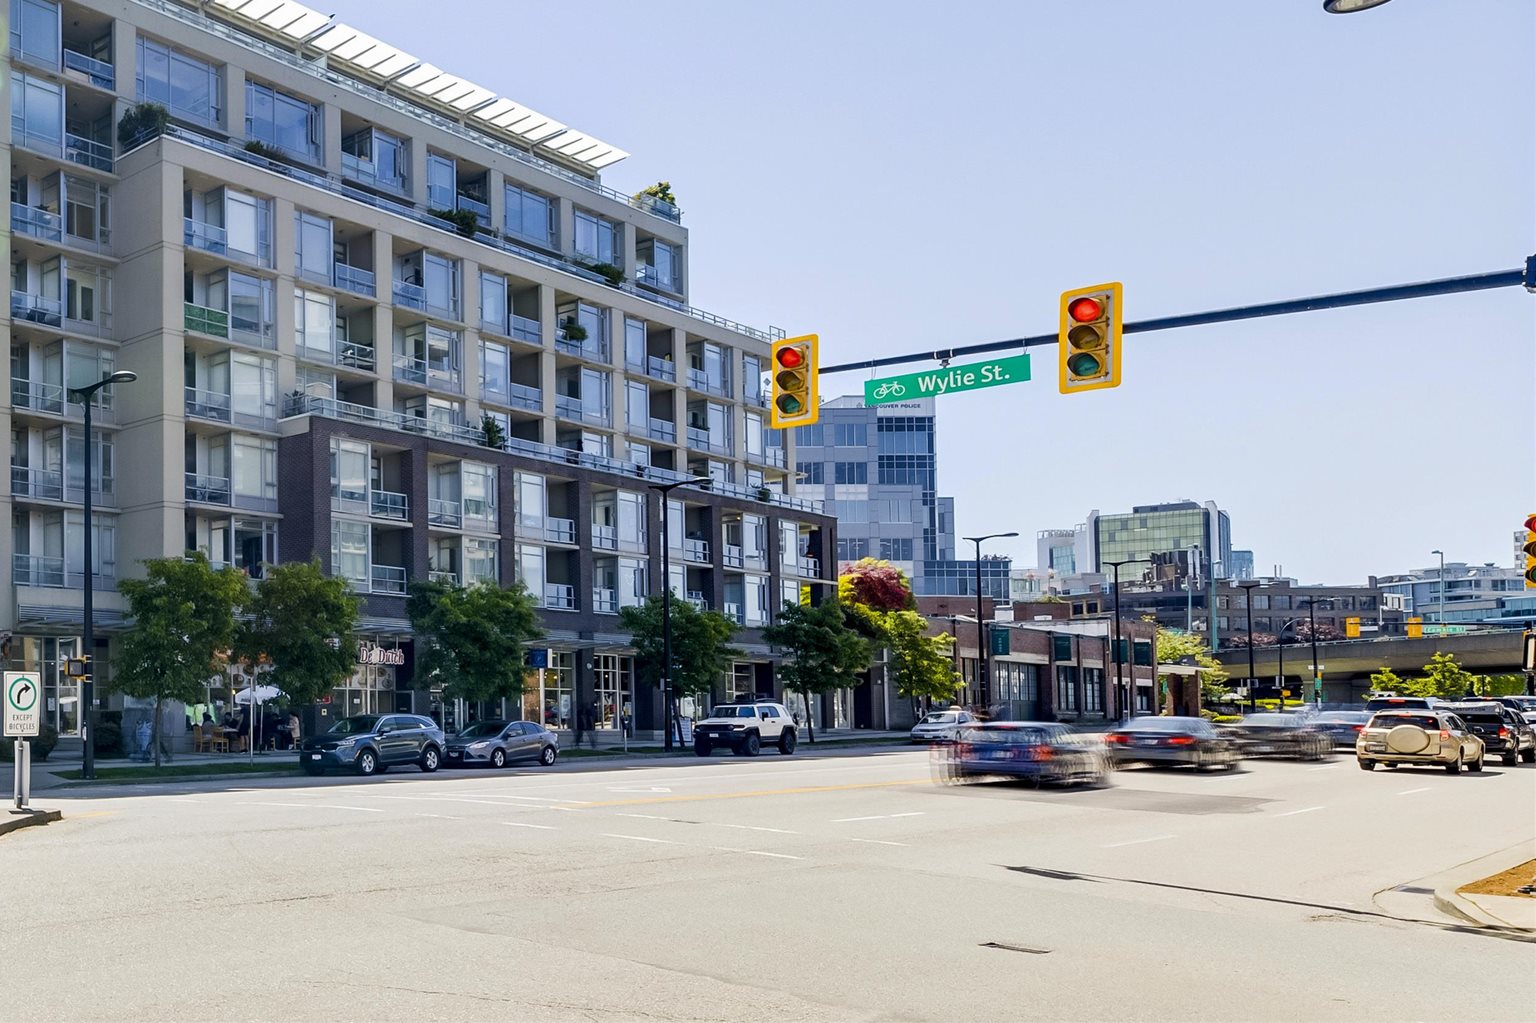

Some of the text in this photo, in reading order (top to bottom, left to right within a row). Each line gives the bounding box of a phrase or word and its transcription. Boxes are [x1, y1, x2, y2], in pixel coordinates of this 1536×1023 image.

[917, 364, 1010, 394] Wylie St.
[360, 647, 405, 665] De Dutch
[9, 722, 35, 730] BICYCLES
